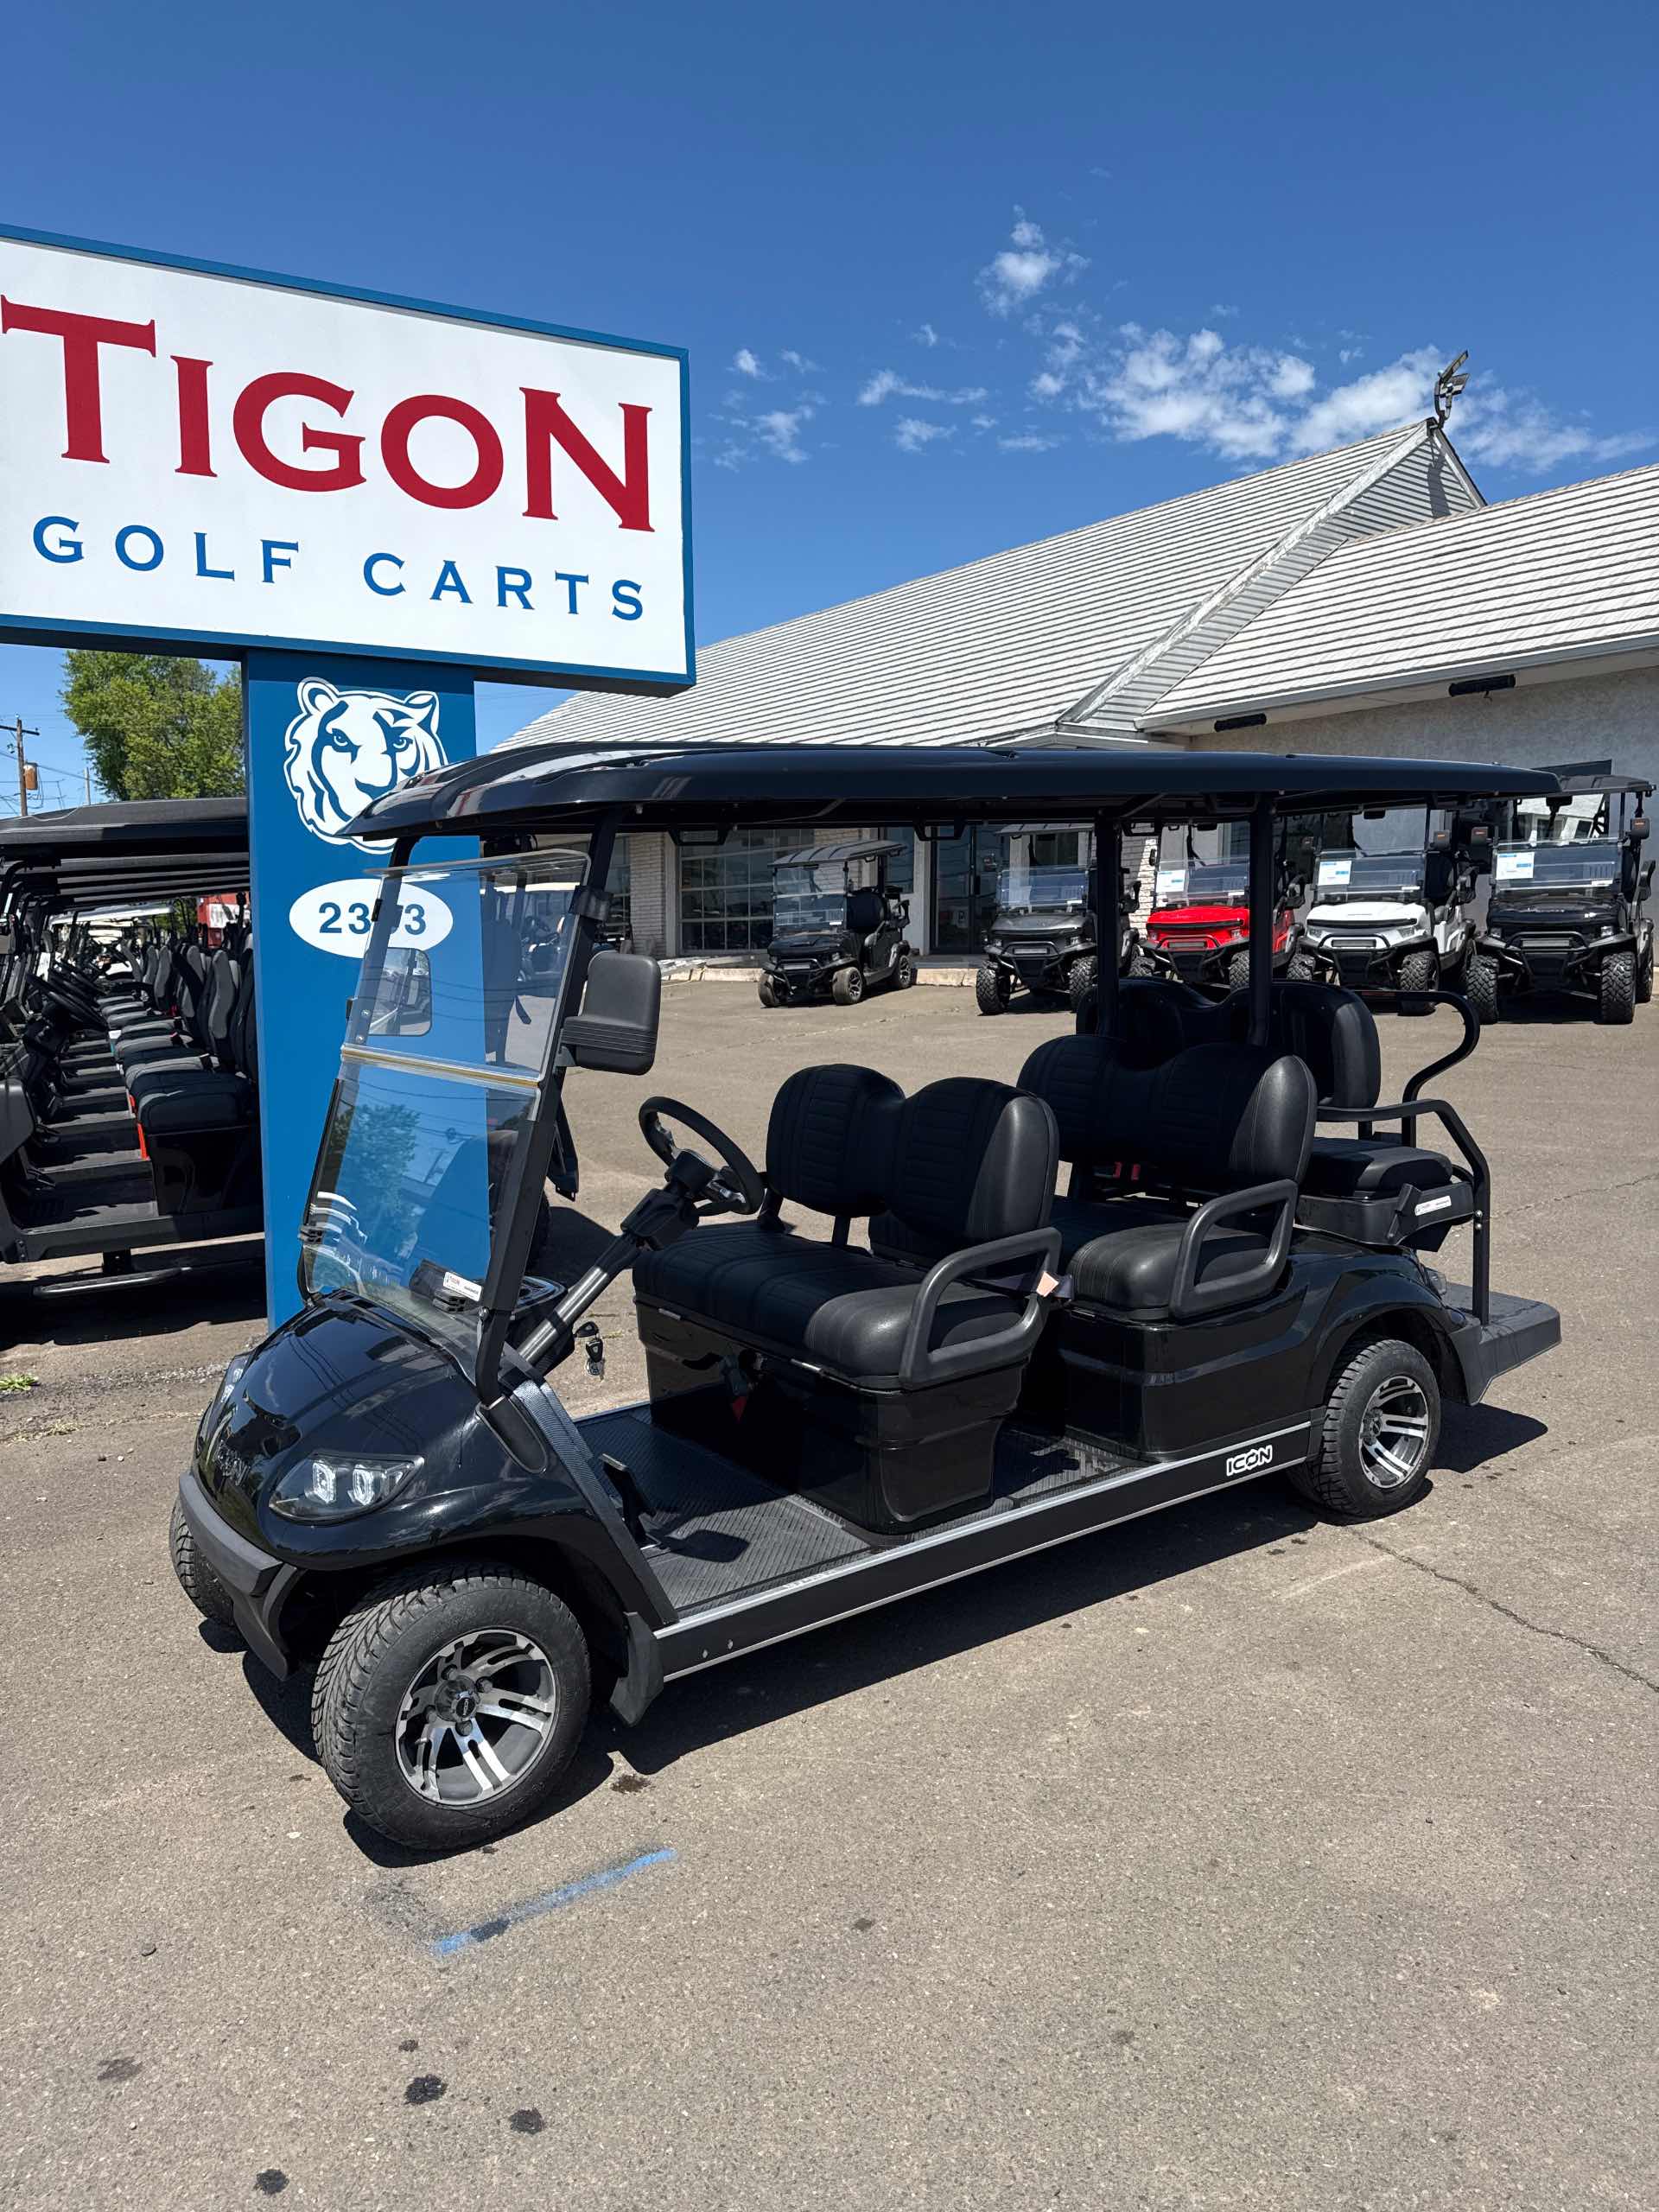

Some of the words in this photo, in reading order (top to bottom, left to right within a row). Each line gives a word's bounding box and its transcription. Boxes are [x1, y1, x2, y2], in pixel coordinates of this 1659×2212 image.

[1, 295, 654, 532] TIGON
[32, 515, 300, 584] GOLF
[363, 552, 645, 621] CARTS
[318, 901, 427, 936] 233
[1226, 1445, 1273, 1477] ICON
